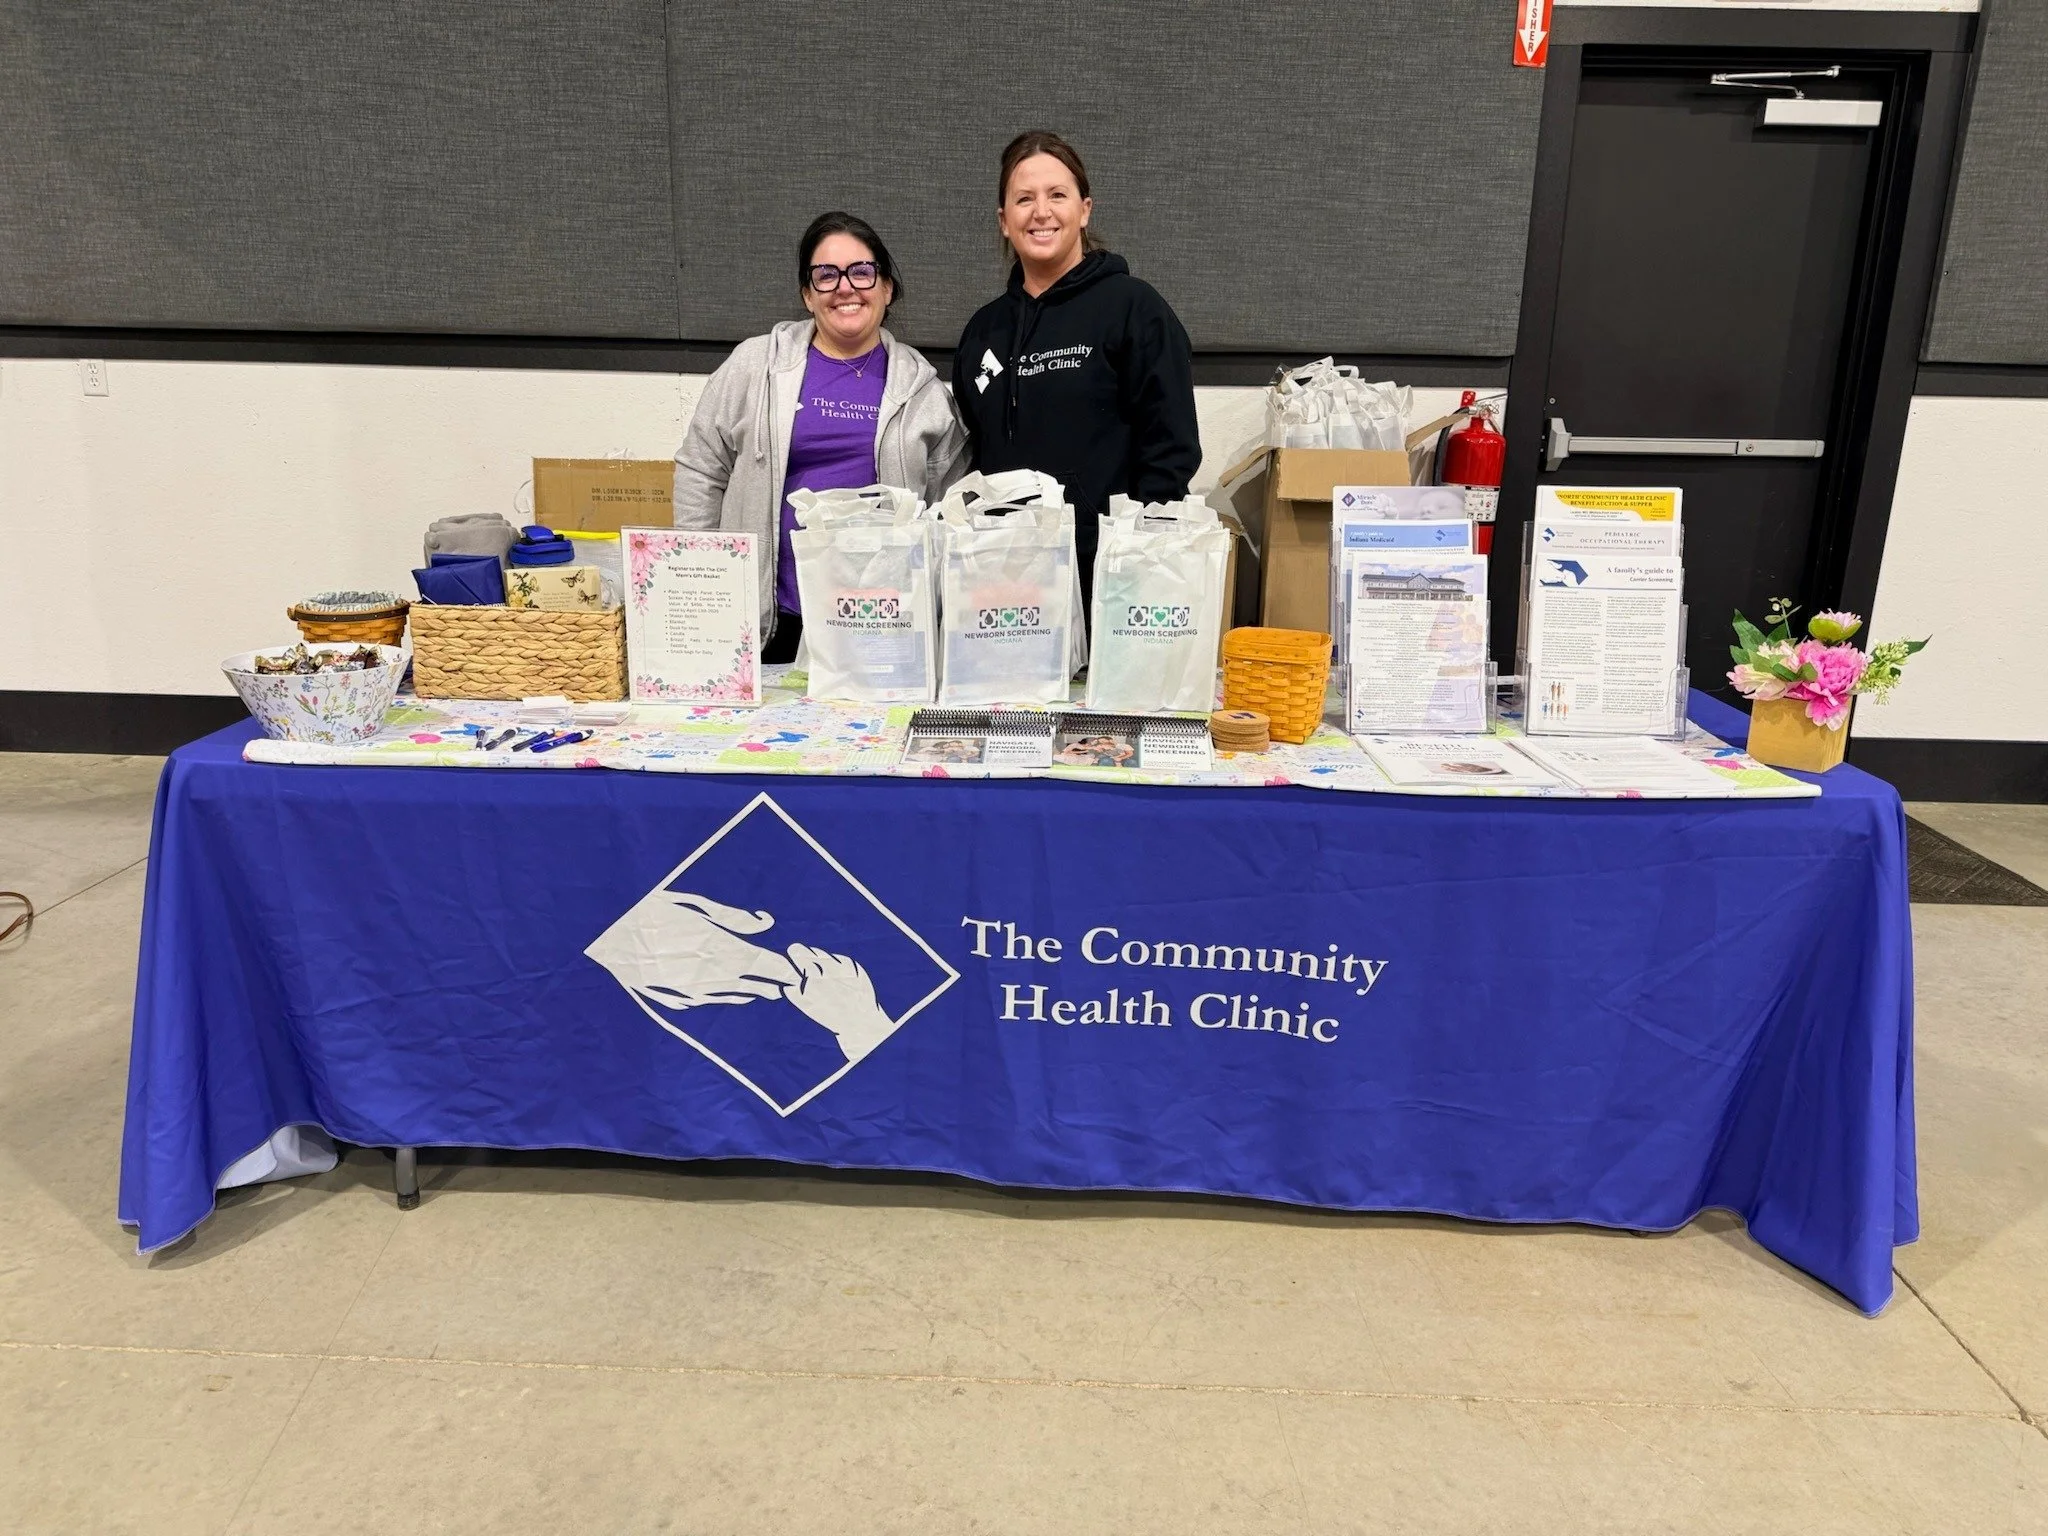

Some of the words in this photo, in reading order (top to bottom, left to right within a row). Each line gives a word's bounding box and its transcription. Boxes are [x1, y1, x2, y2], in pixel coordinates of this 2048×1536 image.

[1029, 344, 1093, 363] Community
[1048, 357, 1081, 370] Clinic
[811, 397, 835, 408] The
[840, 400, 880, 412] Comm
[821, 408, 864, 420] Health
[1614, 567, 1643, 575] family's
[1644, 567, 1665, 575] guide
[826, 619, 864, 628] NEWBORN
[866, 621, 912, 629] SCREENING
[964, 630, 1005, 639] NEWBORN
[1007, 628, 1051, 637] SCREENING
[1112, 629, 1156, 637] NEWBORN
[1157, 628, 1198, 637] SCREENING
[961, 915, 1063, 963] The
[1080, 927, 1389, 996] Community
[1000, 984, 1172, 1027] Health
[1189, 992, 1341, 1043] Clinic
